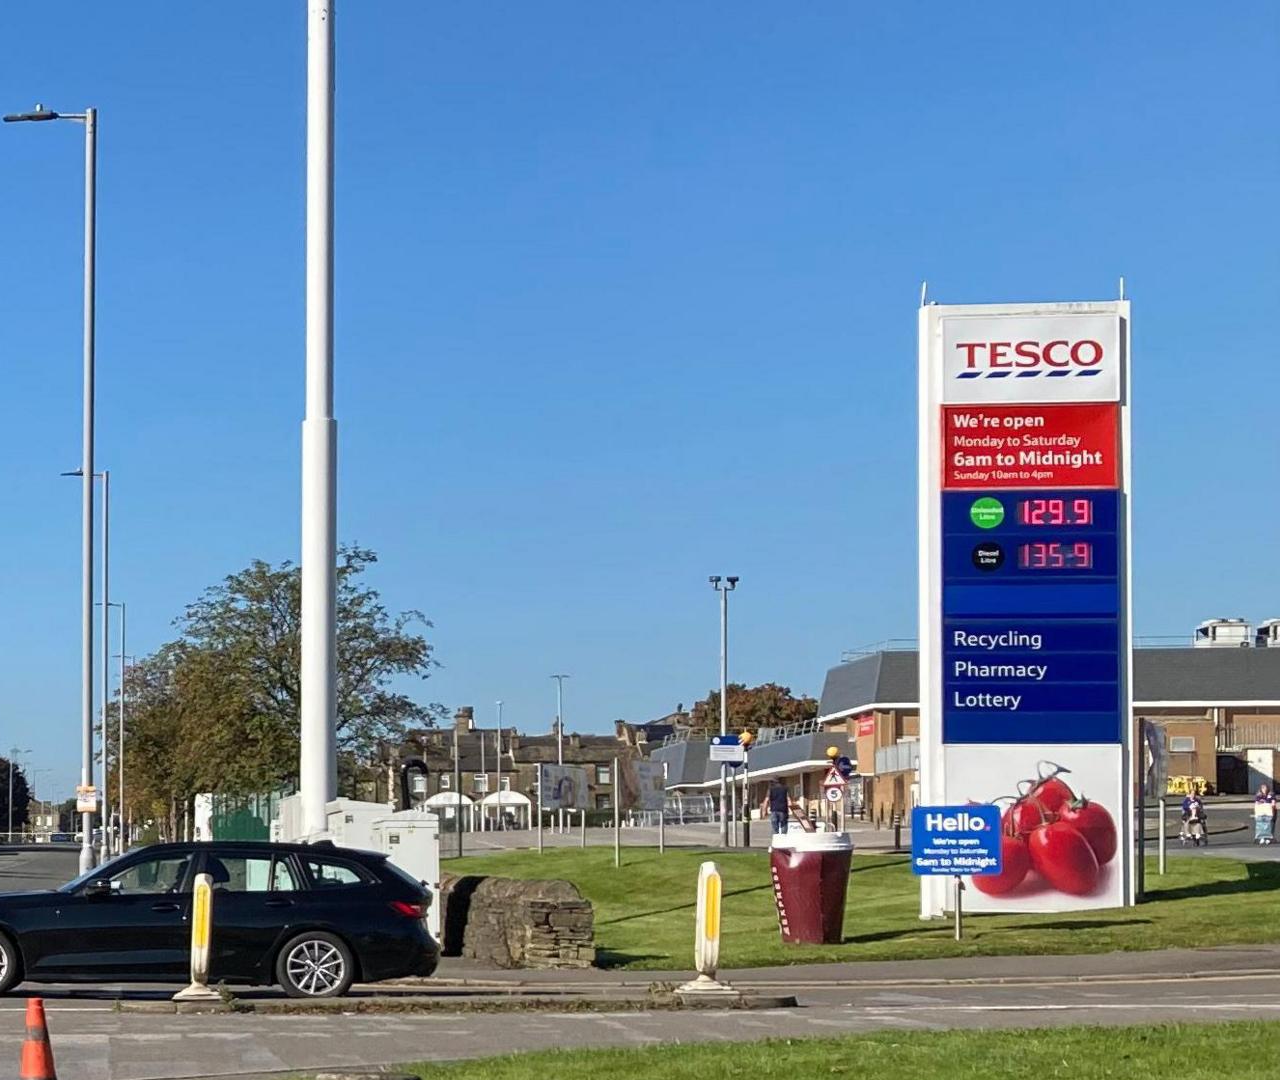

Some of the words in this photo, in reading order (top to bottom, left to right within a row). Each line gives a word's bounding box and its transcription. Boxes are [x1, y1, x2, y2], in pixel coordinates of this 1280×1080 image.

[956, 340, 1104, 369] TESCO
[953, 413, 1000, 428] We're
[1003, 416, 1044, 430] open
[954, 435, 1004, 448] Monday
[1007, 435, 1020, 446] to
[1022, 433, 1081, 448] Saturday
[953, 451, 992, 466] 6am
[997, 451, 1015, 466] to
[1020, 450, 1102, 468] Midnight
[953, 470, 989, 481] Sunday
[991, 470, 1018, 480] 10am
[1019, 470, 1030, 479] to
[1031, 470, 1053, 481] 4pm
[1023, 500, 1089, 524] 129.9
[954, 631, 1042, 650] Recycling
[955, 661, 1047, 680] Pharmacy
[955, 691, 1021, 710] Lottery
[830, 790, 839, 798] 5
